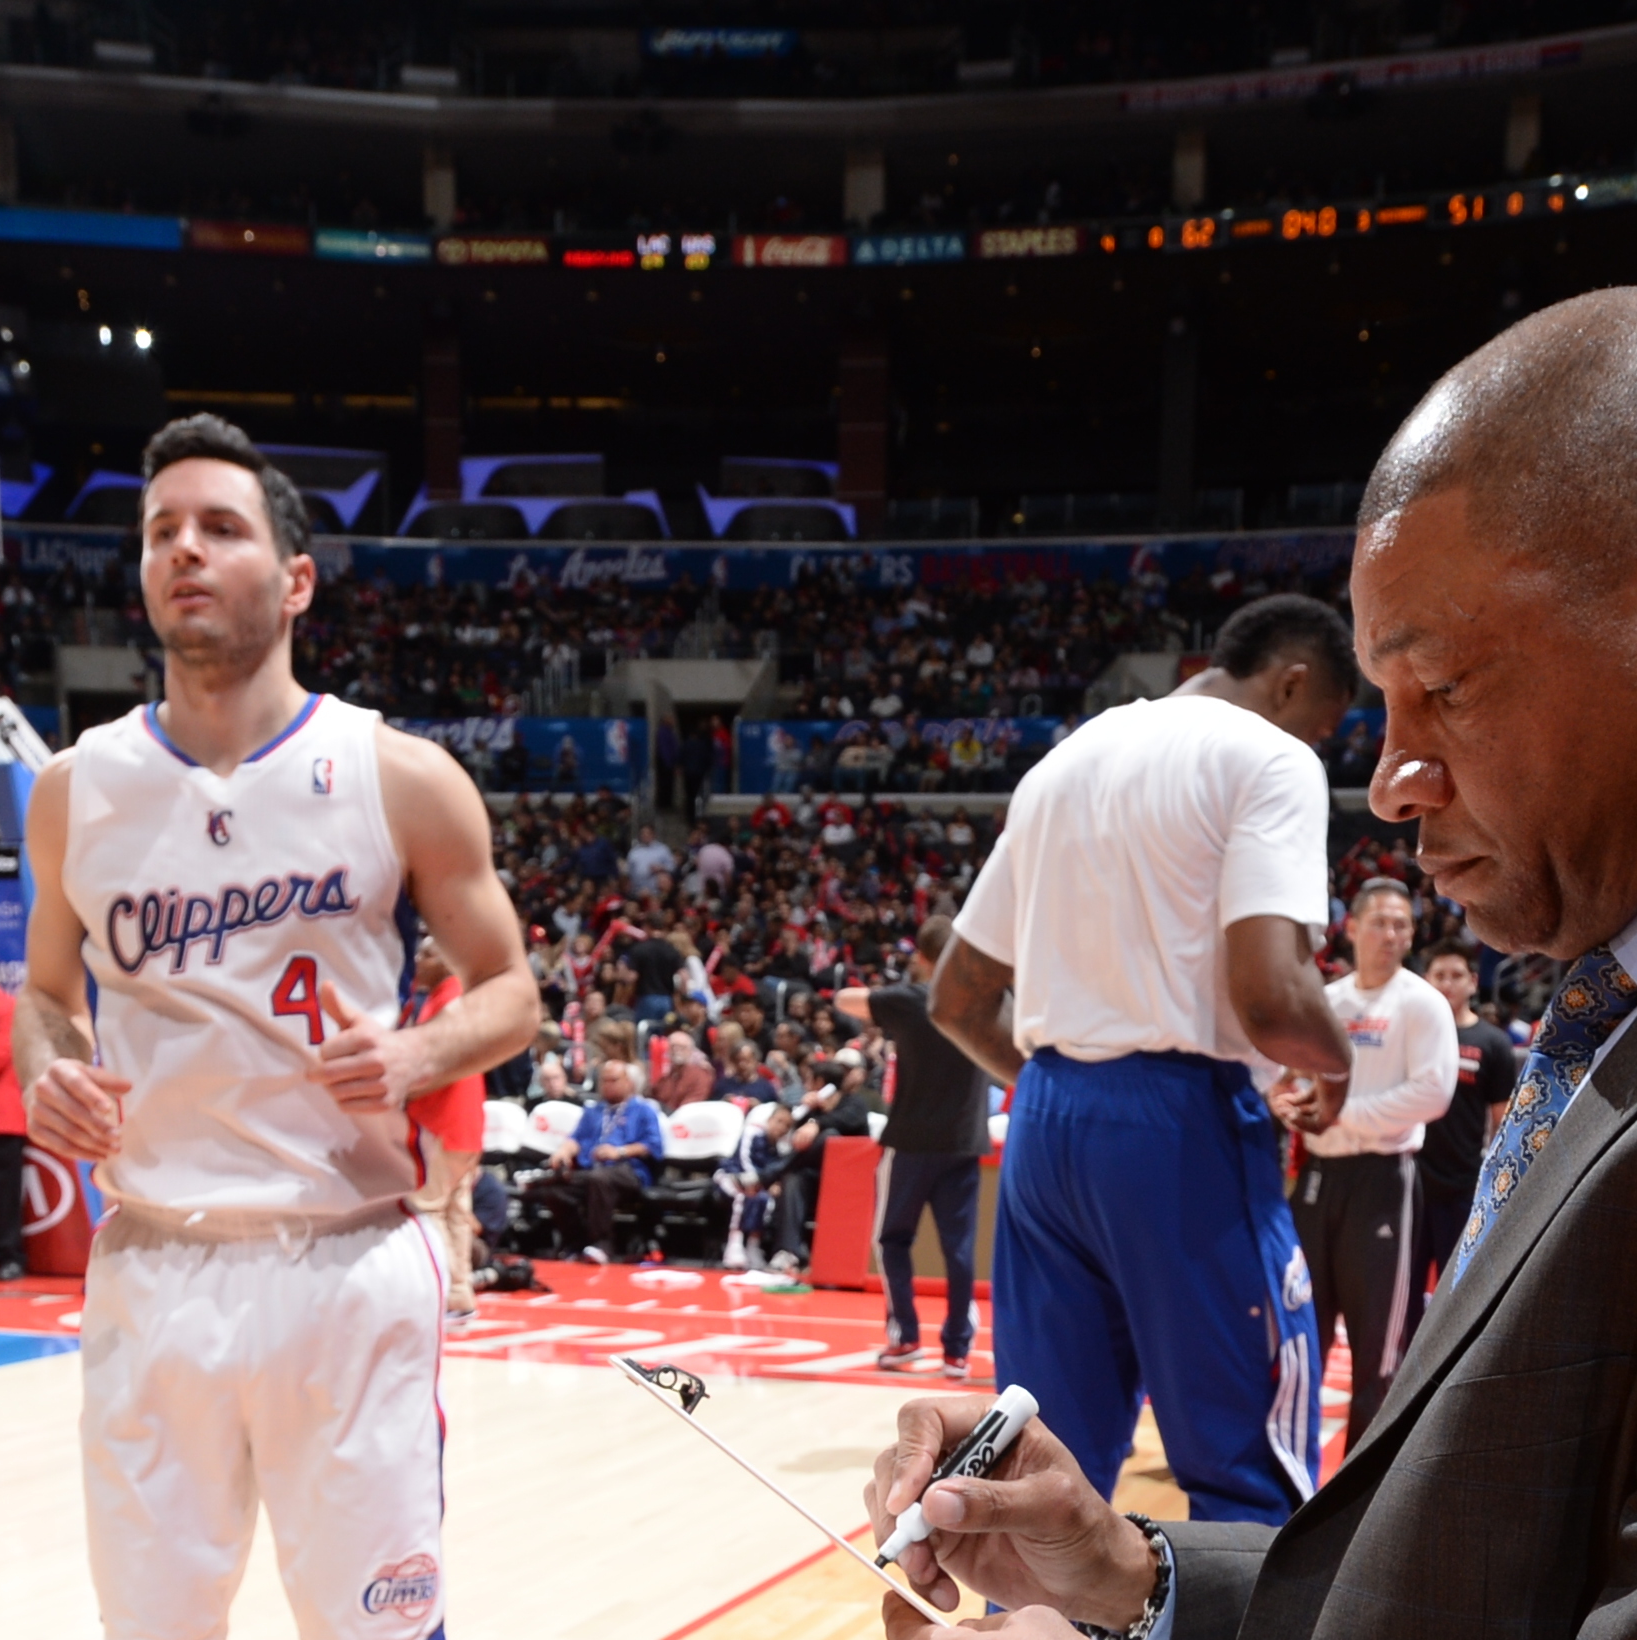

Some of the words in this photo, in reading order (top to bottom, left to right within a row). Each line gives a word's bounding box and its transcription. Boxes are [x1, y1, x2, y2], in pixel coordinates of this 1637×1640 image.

[471, 238, 549, 264] TOYOTA
[880, 235, 964, 262] DELTA
[980, 226, 1078, 257] STAPLES
[107, 866, 361, 975] Clippers
[270, 955, 325, 1046] 4
[363, 1574, 436, 1616] CLIPPERS
